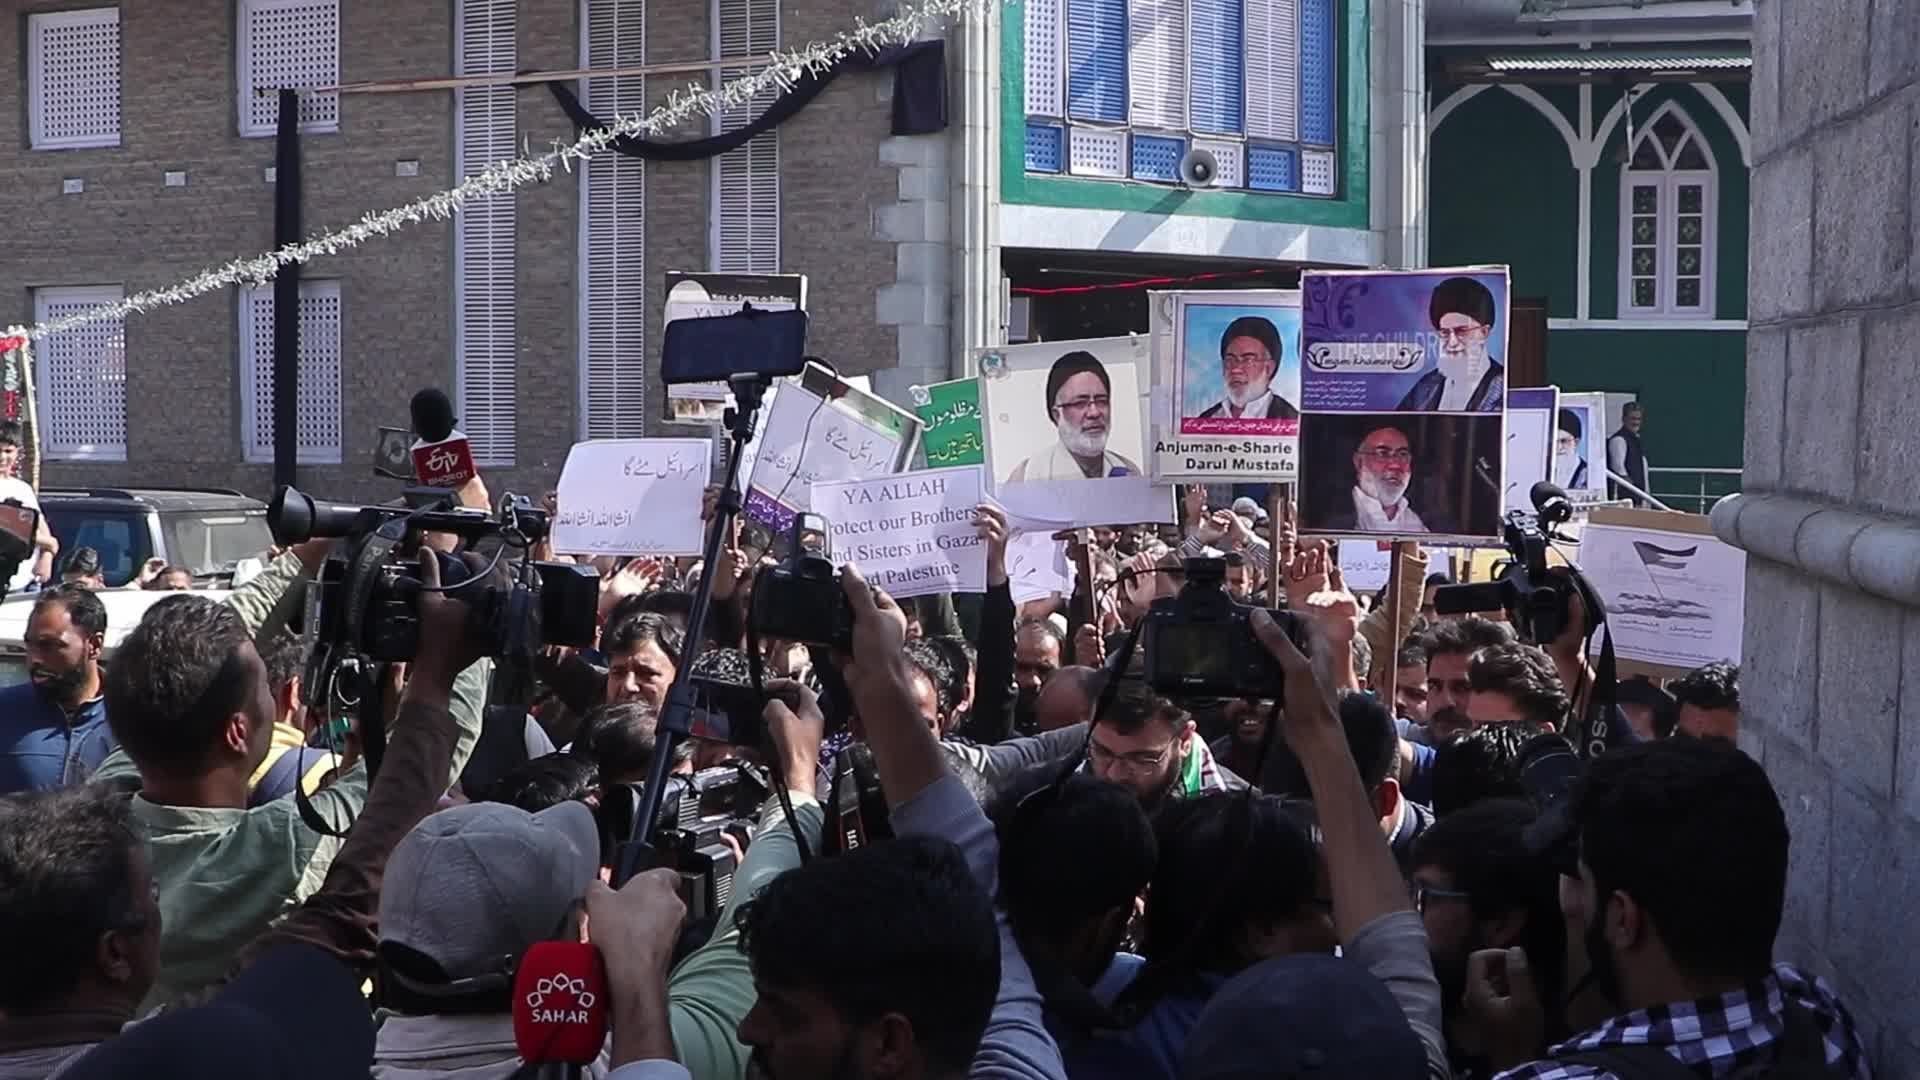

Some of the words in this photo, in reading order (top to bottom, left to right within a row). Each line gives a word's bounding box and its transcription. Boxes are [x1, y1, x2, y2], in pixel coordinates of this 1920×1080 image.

[1155, 441, 1292, 455] Anjuman-e-Sharie
[656, 450, 704, 480] اسرائیل
[1186, 458, 1227, 470] Darul
[1232, 458, 1295, 471] Mustafa
[843, 488, 873, 505] YA
[879, 478, 946, 501] ALLAH
[831, 519, 875, 536] otect
[879, 516, 907, 532] our
[911, 506, 979, 527] Brothers
[833, 546, 853, 562] nd
[858, 543, 912, 561] Sisters
[916, 539, 932, 555] in
[936, 534, 979, 550] Gaza
[864, 571, 881, 586] nd
[886, 561, 960, 584] Palestine
[531, 1008, 589, 1024] SAHAR
